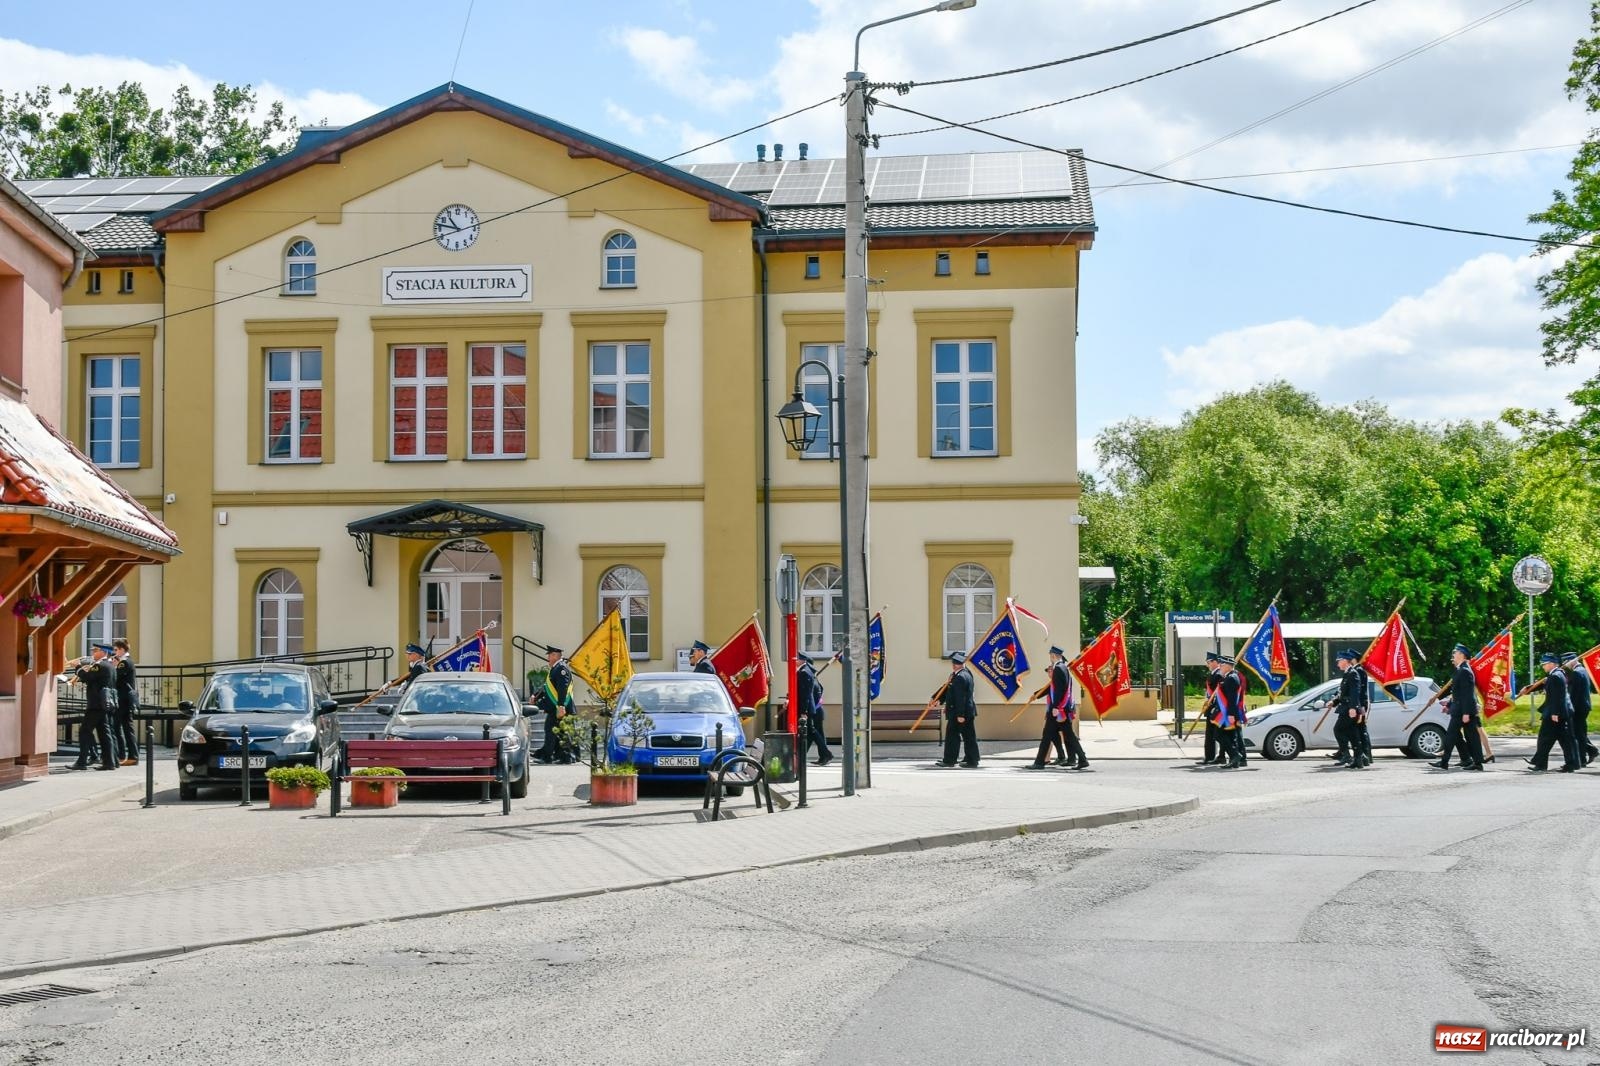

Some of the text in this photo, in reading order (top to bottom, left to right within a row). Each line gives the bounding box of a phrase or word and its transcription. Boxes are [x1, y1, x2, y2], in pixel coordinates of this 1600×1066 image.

[455, 208, 461, 216] 12
[441, 216, 447, 224] 10
[470, 216, 474, 224] 2
[396, 277, 517, 291] STACJA KULTURA
[225, 757, 265, 767] SRC C19
[659, 757, 697, 766] SRC MG18
